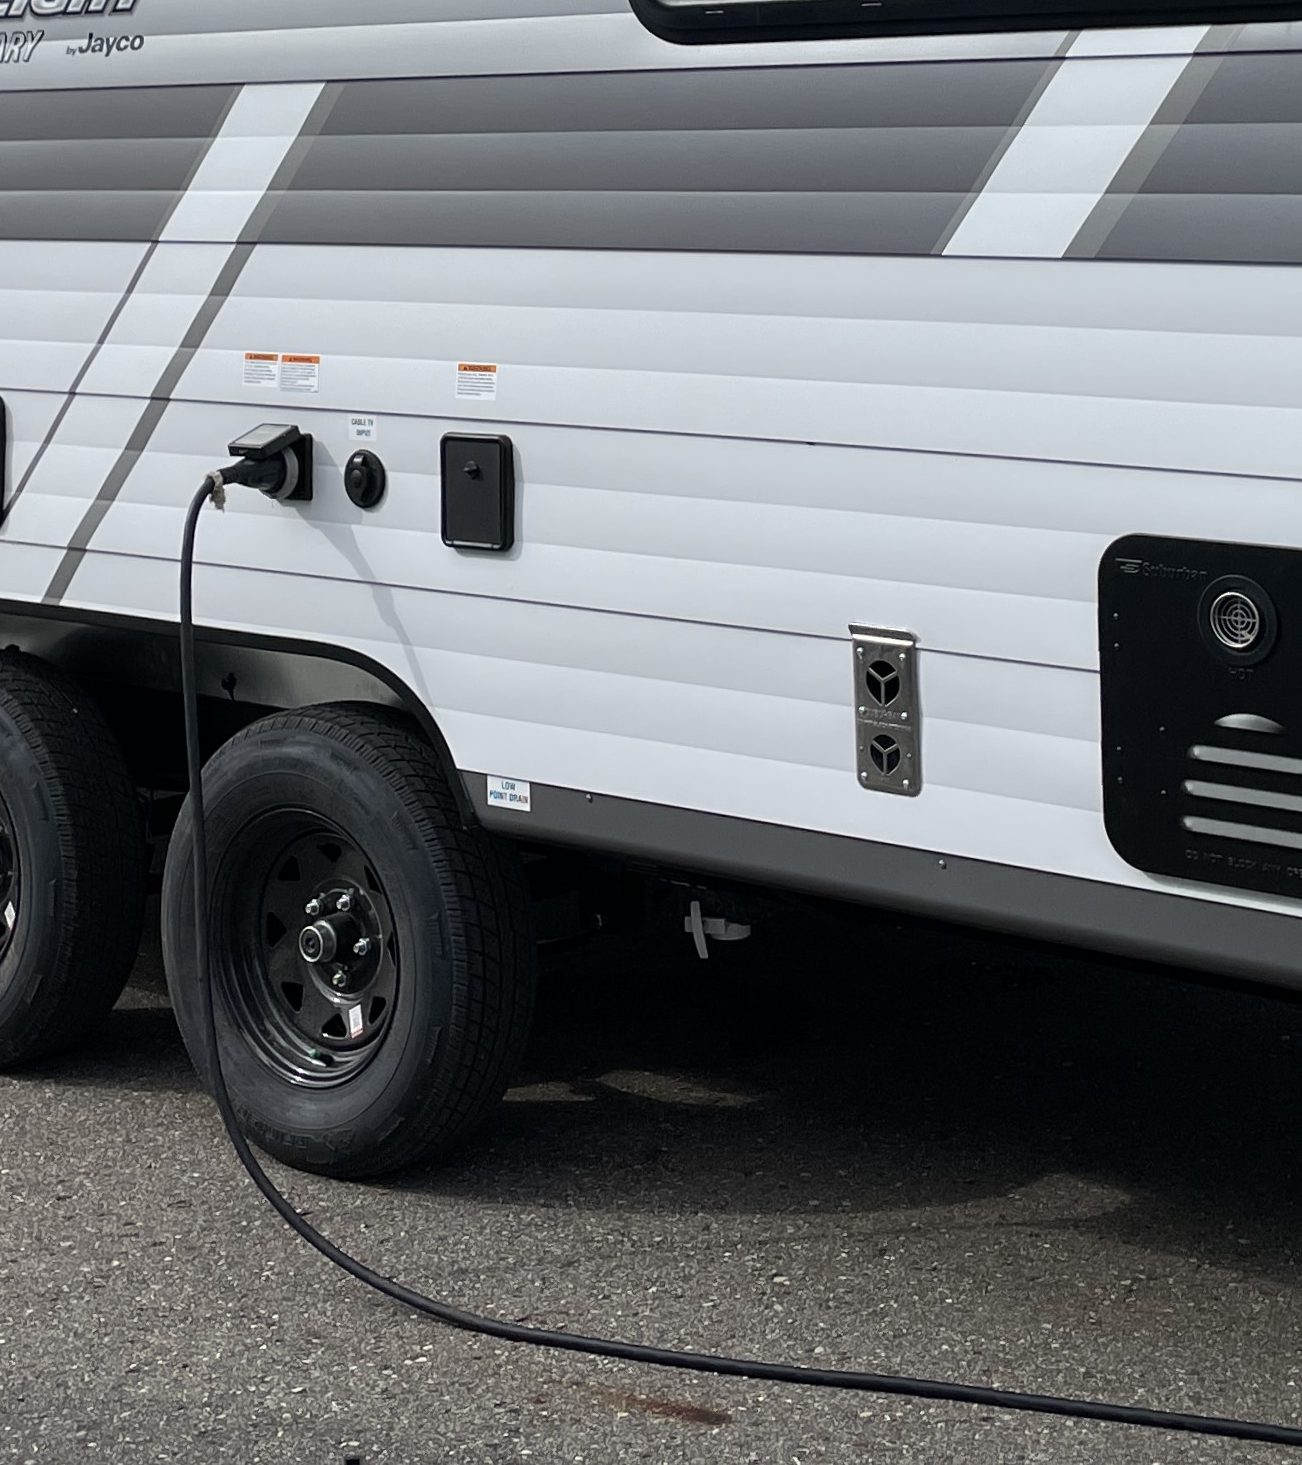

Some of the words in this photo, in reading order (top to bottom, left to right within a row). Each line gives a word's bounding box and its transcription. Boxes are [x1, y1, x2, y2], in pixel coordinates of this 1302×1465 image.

[78, 32, 144, 57] Jayco
[501, 781, 516, 791] LOW
[489, 790, 507, 801] POINT
[509, 794, 528, 804] DRAIN
